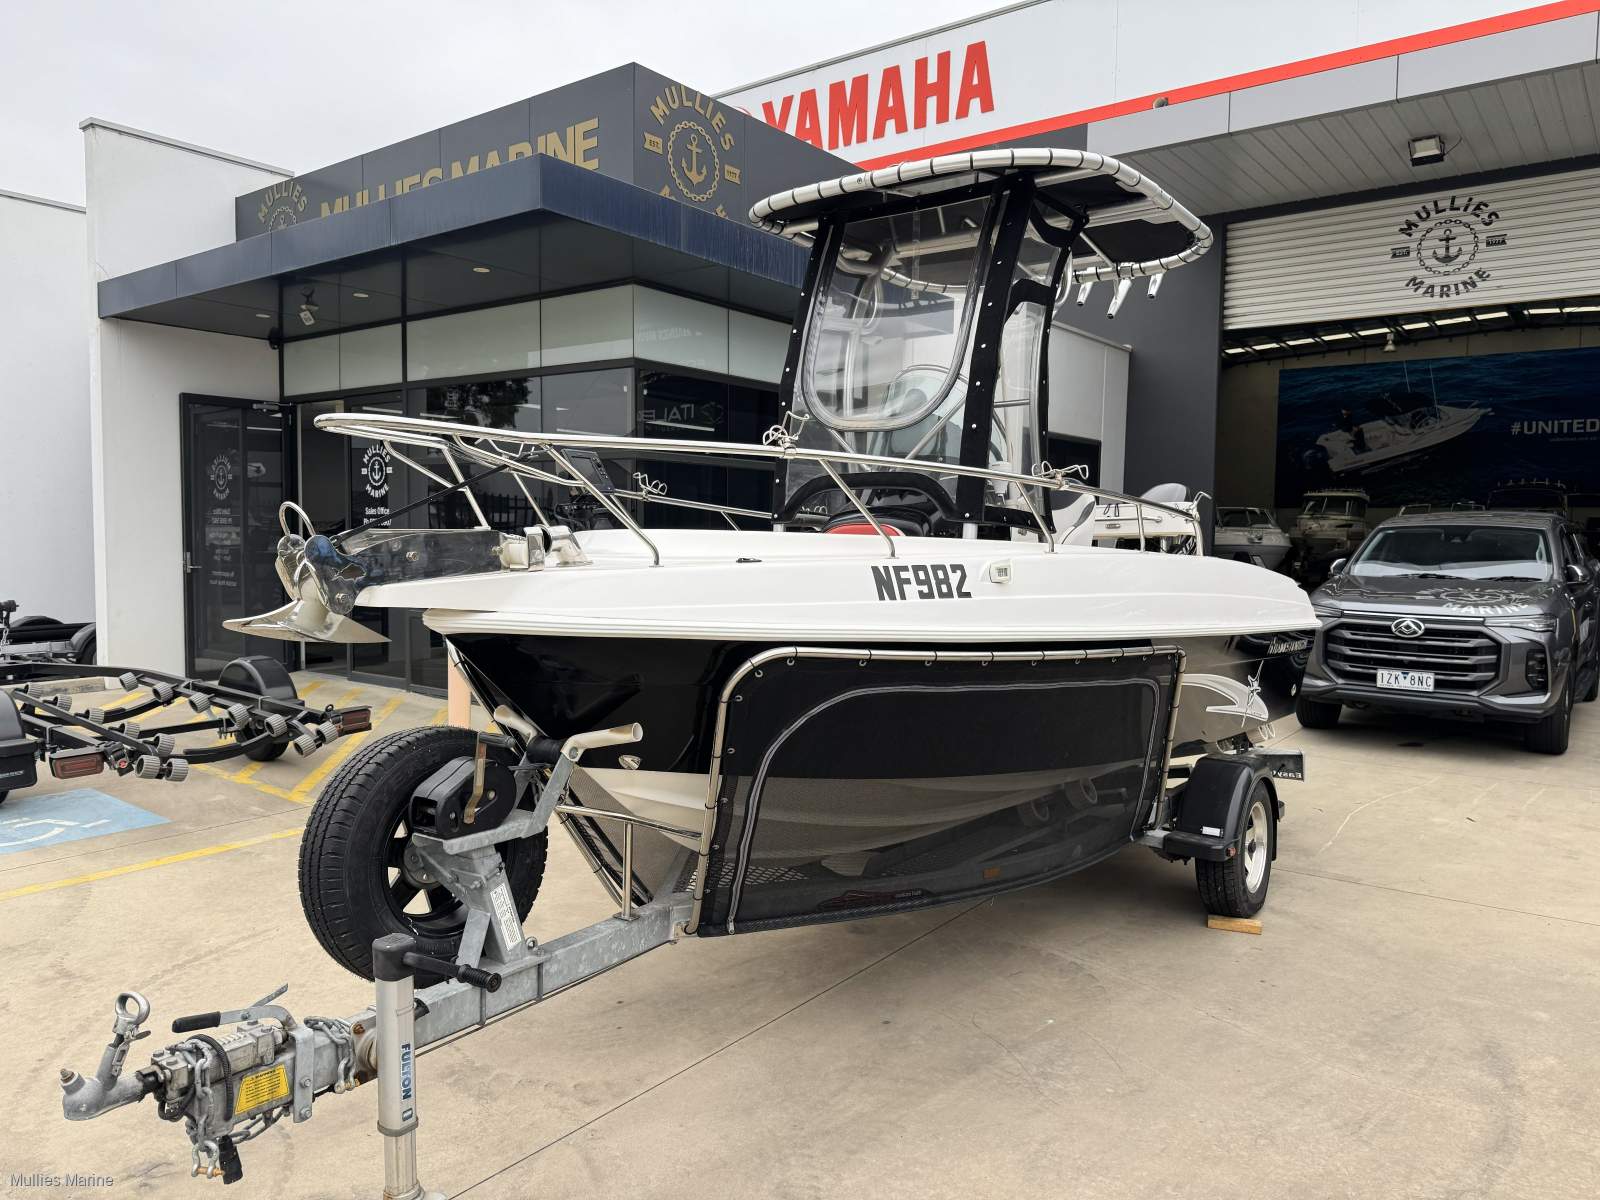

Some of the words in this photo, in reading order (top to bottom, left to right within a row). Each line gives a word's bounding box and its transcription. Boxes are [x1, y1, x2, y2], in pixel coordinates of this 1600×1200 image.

[650, 84, 735, 151] MULLIES
[258, 180, 308, 223] MULLIES
[1398, 196, 1500, 237] MULLIES
[1405, 267, 1491, 298] MARINE
[363, 444, 391, 464] MULLIES
[365, 483, 389, 498] MARINE
[871, 563, 973, 601] NF982
[401, 1043, 412, 1100] FULTON
